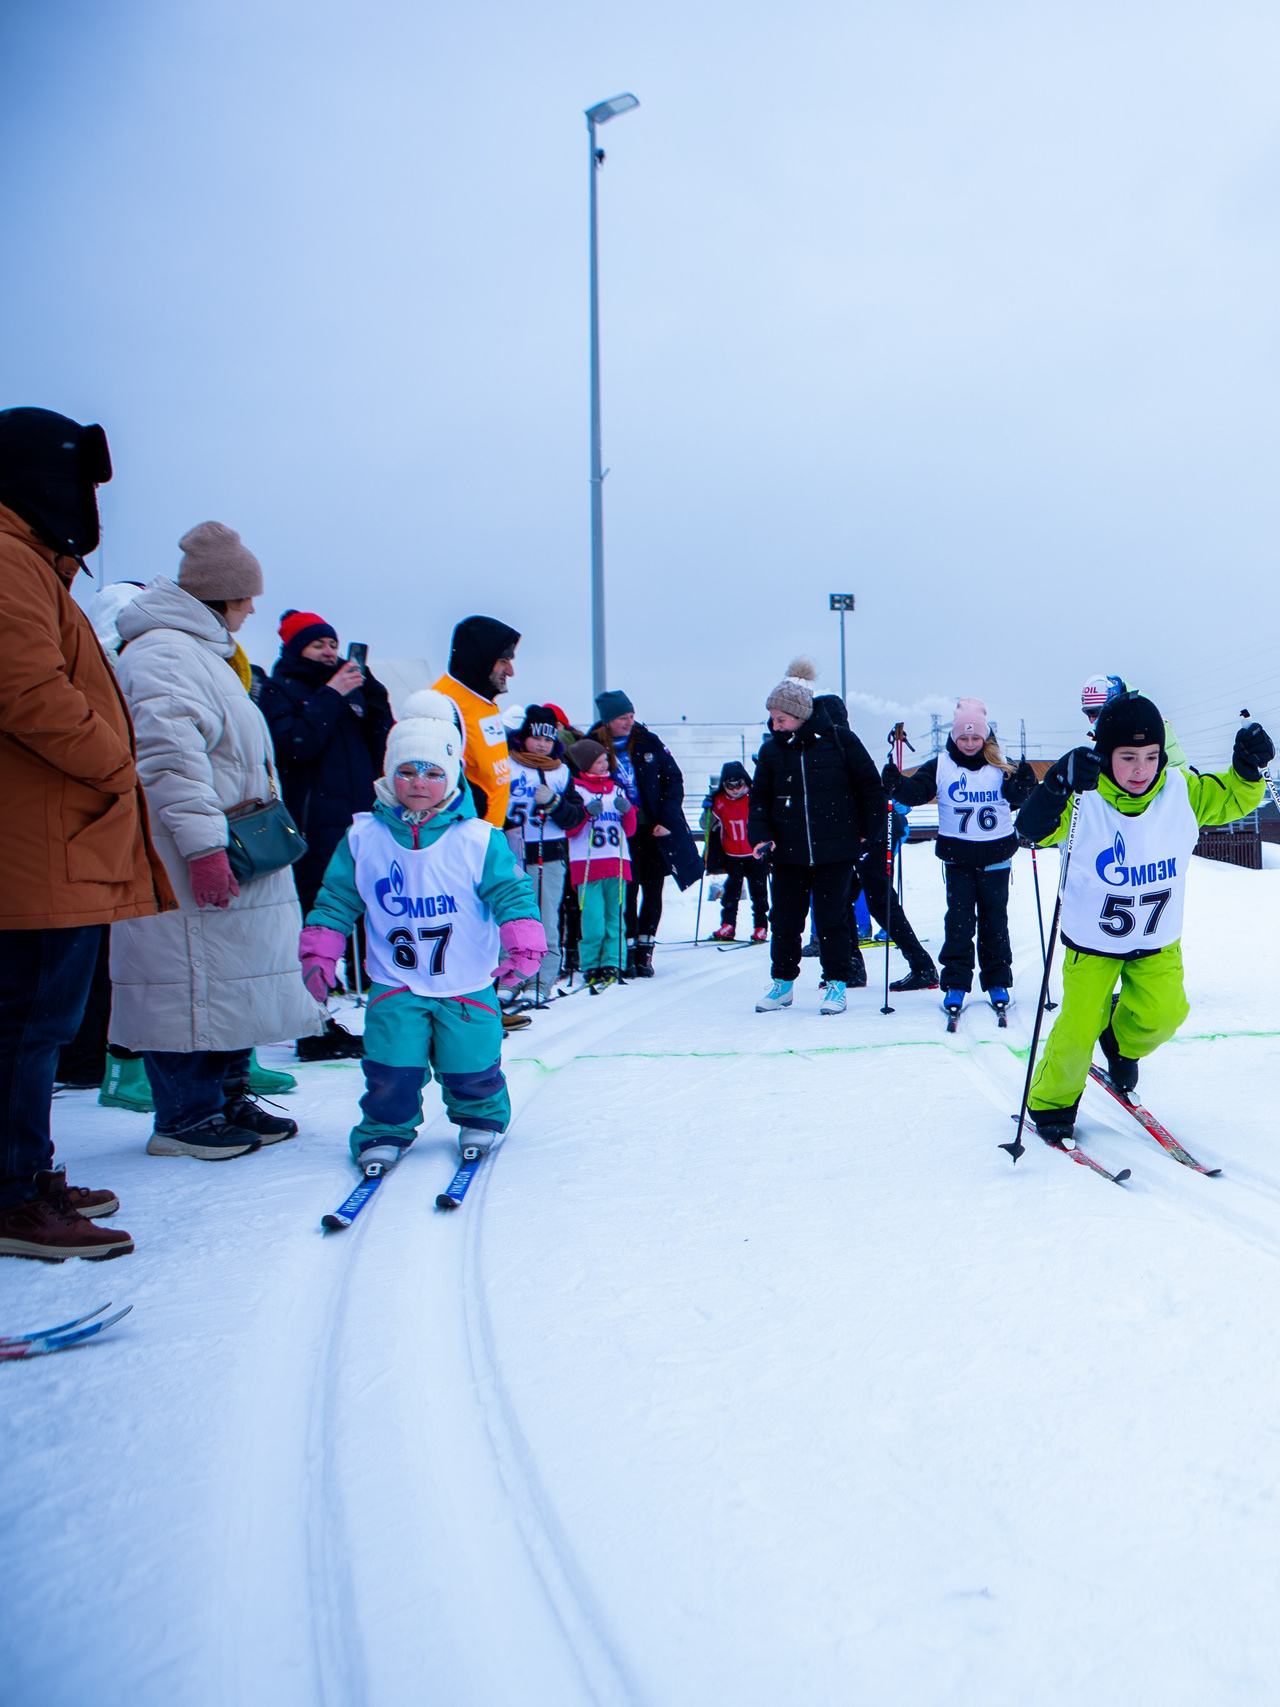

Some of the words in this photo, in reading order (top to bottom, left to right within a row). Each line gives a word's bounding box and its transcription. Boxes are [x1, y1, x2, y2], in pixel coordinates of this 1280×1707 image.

[953, 805, 998, 834] 76
[592, 825, 620, 849] 68
[1130, 857, 1177, 887] МОЭК
[1098, 888, 1172, 938] 57
[386, 922, 453, 976] 67
